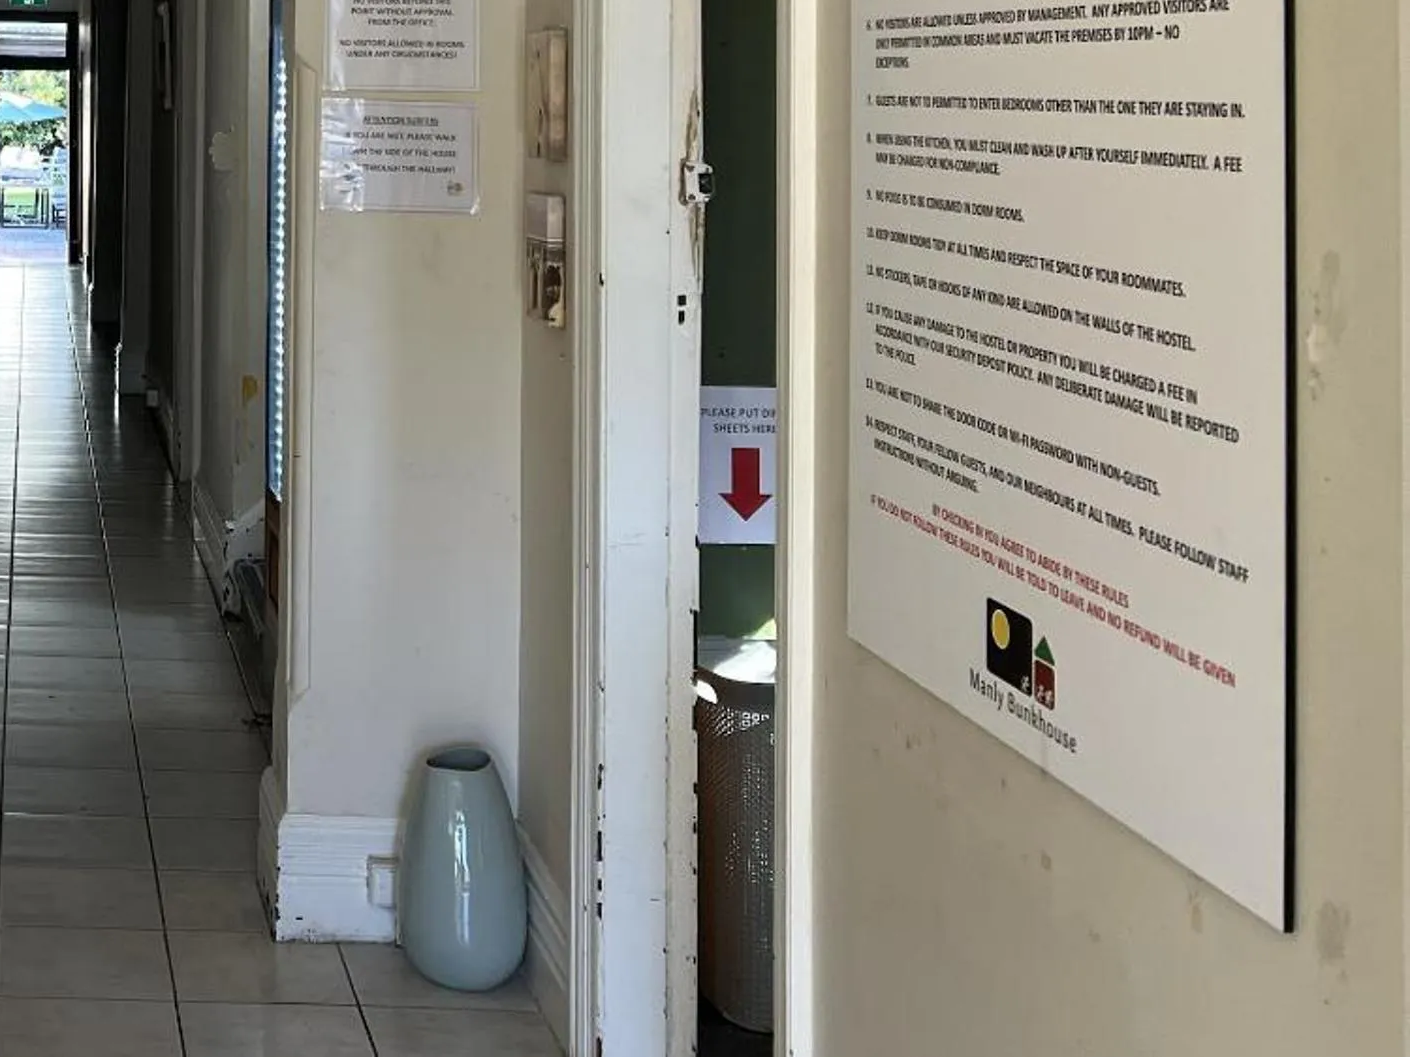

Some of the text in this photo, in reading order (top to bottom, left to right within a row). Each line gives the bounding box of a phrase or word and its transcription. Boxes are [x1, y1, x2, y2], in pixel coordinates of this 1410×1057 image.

[376, 7, 412, 16] WITHOUT
[1091, 2, 1109, 19] ANY
[1111, 0, 1161, 18] APPROVED
[1070, 26, 1113, 43] PREMISES
[1113, 26, 1125, 42] BY
[1127, 24, 1154, 41] 10PM
[1163, 23, 1180, 40] NO
[373, 50, 390, 59] ANY
[1098, 98, 1115, 115] THE
[1116, 99, 1136, 115] ONE
[1138, 99, 1162, 116] THEY
[1164, 99, 1183, 117] ARE
[1185, 100, 1228, 118] STAYING
[1229, 101, 1248, 119] IN.
[1095, 146, 1139, 165] YOURSELF
[1140, 149, 1208, 170] IMMEDIATELY.
[1213, 153, 1221, 171] A
[1222, 154, 1242, 173] FEE
[1081, 263, 1188, 299] OF YOUR ROOMMATES.
[1091, 312, 1121, 335] WALLS
[1121, 318, 1135, 338] OF
[1136, 321, 1154, 343] THE
[1155, 325, 1198, 353] HOSTEL.
[1077, 356, 1198, 406] WILL BE CHARGED A FEE IN
[701, 407, 736, 417] PLEASE
[737, 407, 758, 418] PUT
[1103, 387, 1240, 445] DAMAGE WILL BE REPORTED
[712, 423, 751, 434] SHEETS
[1099, 457, 1162, 498] NON-GUESTS.
[1087, 501, 1103, 526] ALL
[1138, 521, 1172, 554] PLEASE
[1173, 535, 1216, 572] FOLLOW
[1217, 552, 1249, 585] STAFF
[1100, 580, 1129, 610] RULES
[1086, 596, 1236, 689] AND NO REFUND WILL BE GIVEN
[969, 668, 1078, 753] Manly Bunkhouse
